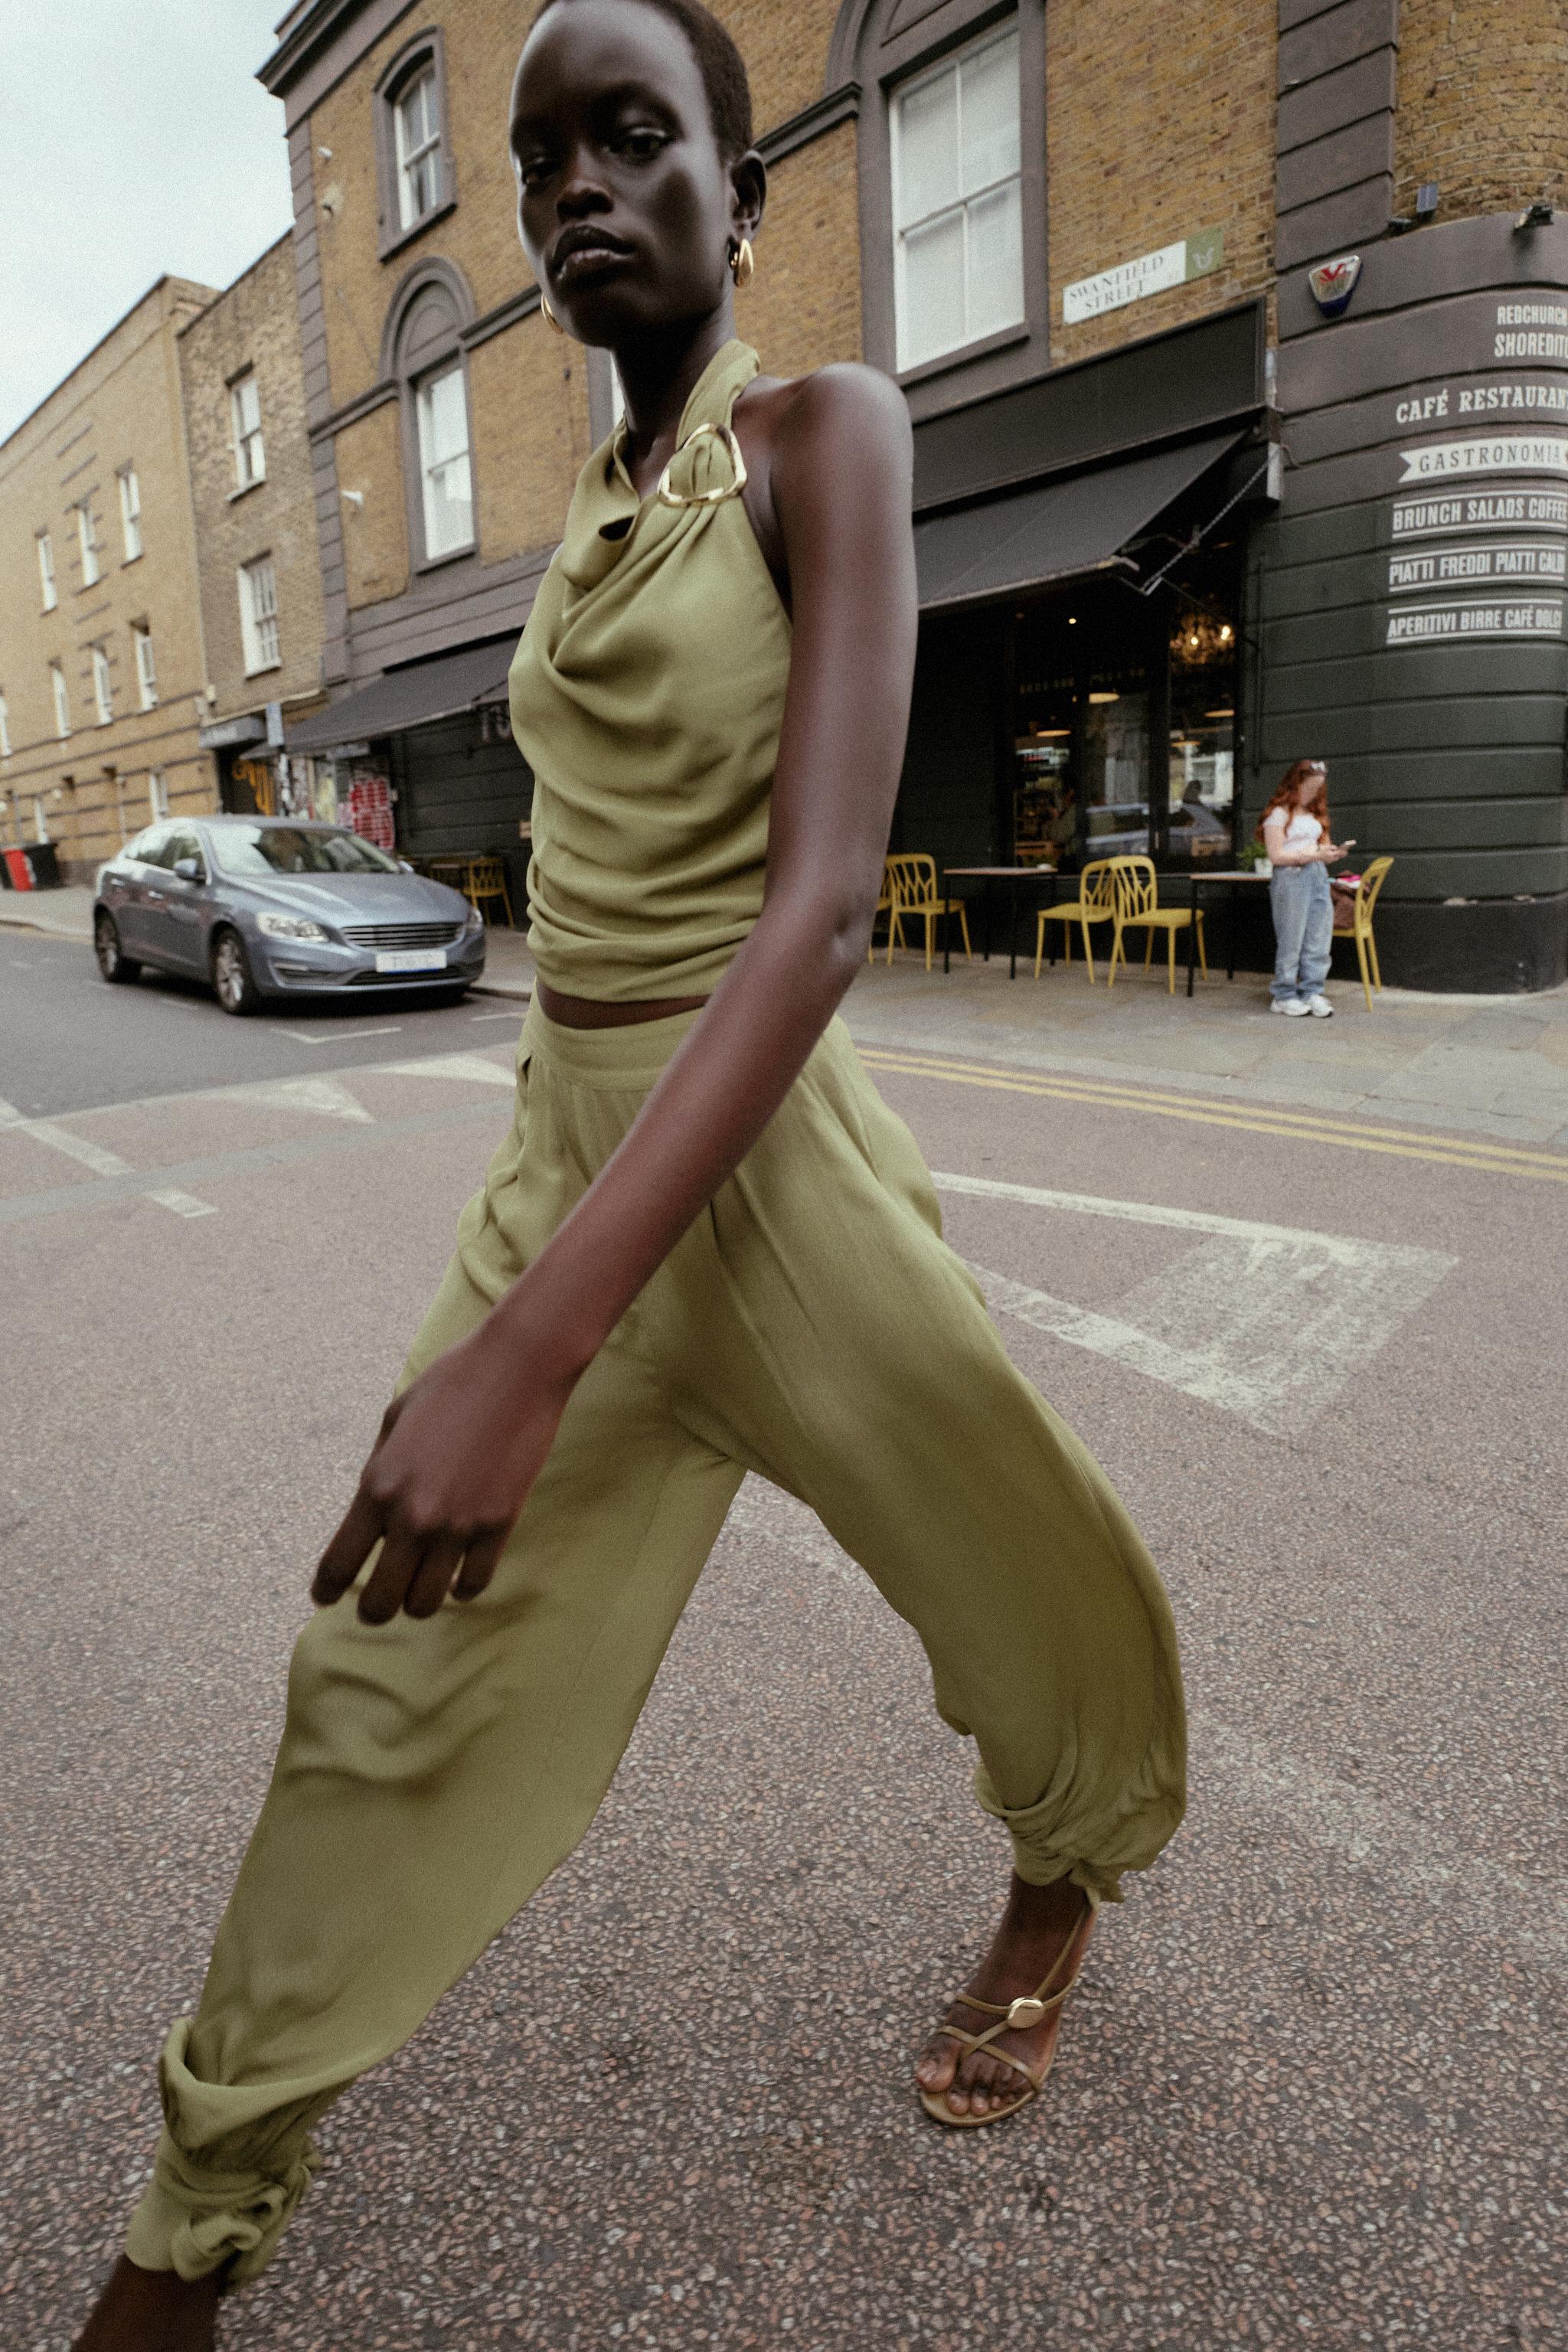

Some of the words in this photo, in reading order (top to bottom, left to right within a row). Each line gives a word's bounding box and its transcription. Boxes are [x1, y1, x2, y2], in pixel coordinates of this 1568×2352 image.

[1070, 255, 1164, 301] SWANFIELD
[1085, 278, 1147, 311] STREET
[1396, 388, 1449, 424] CAFÉ
[1459, 386, 1568, 413] RESTAURAN
[1419, 444, 1560, 472] GASTRONOMIA
[1393, 502, 1462, 531] BRUNCH
[1468, 498, 1524, 521] SALADS
[1528, 498, 1567, 522] COFFEE
[1390, 559, 1435, 585] PIATTI
[1439, 553, 1491, 577] FREDDI
[1495, 551, 1536, 573] PIATTI
[1387, 612, 1456, 638] APERITIVI
[1461, 609, 1502, 630] BIRRE
[1504, 605, 1534, 629] CAFÉ
